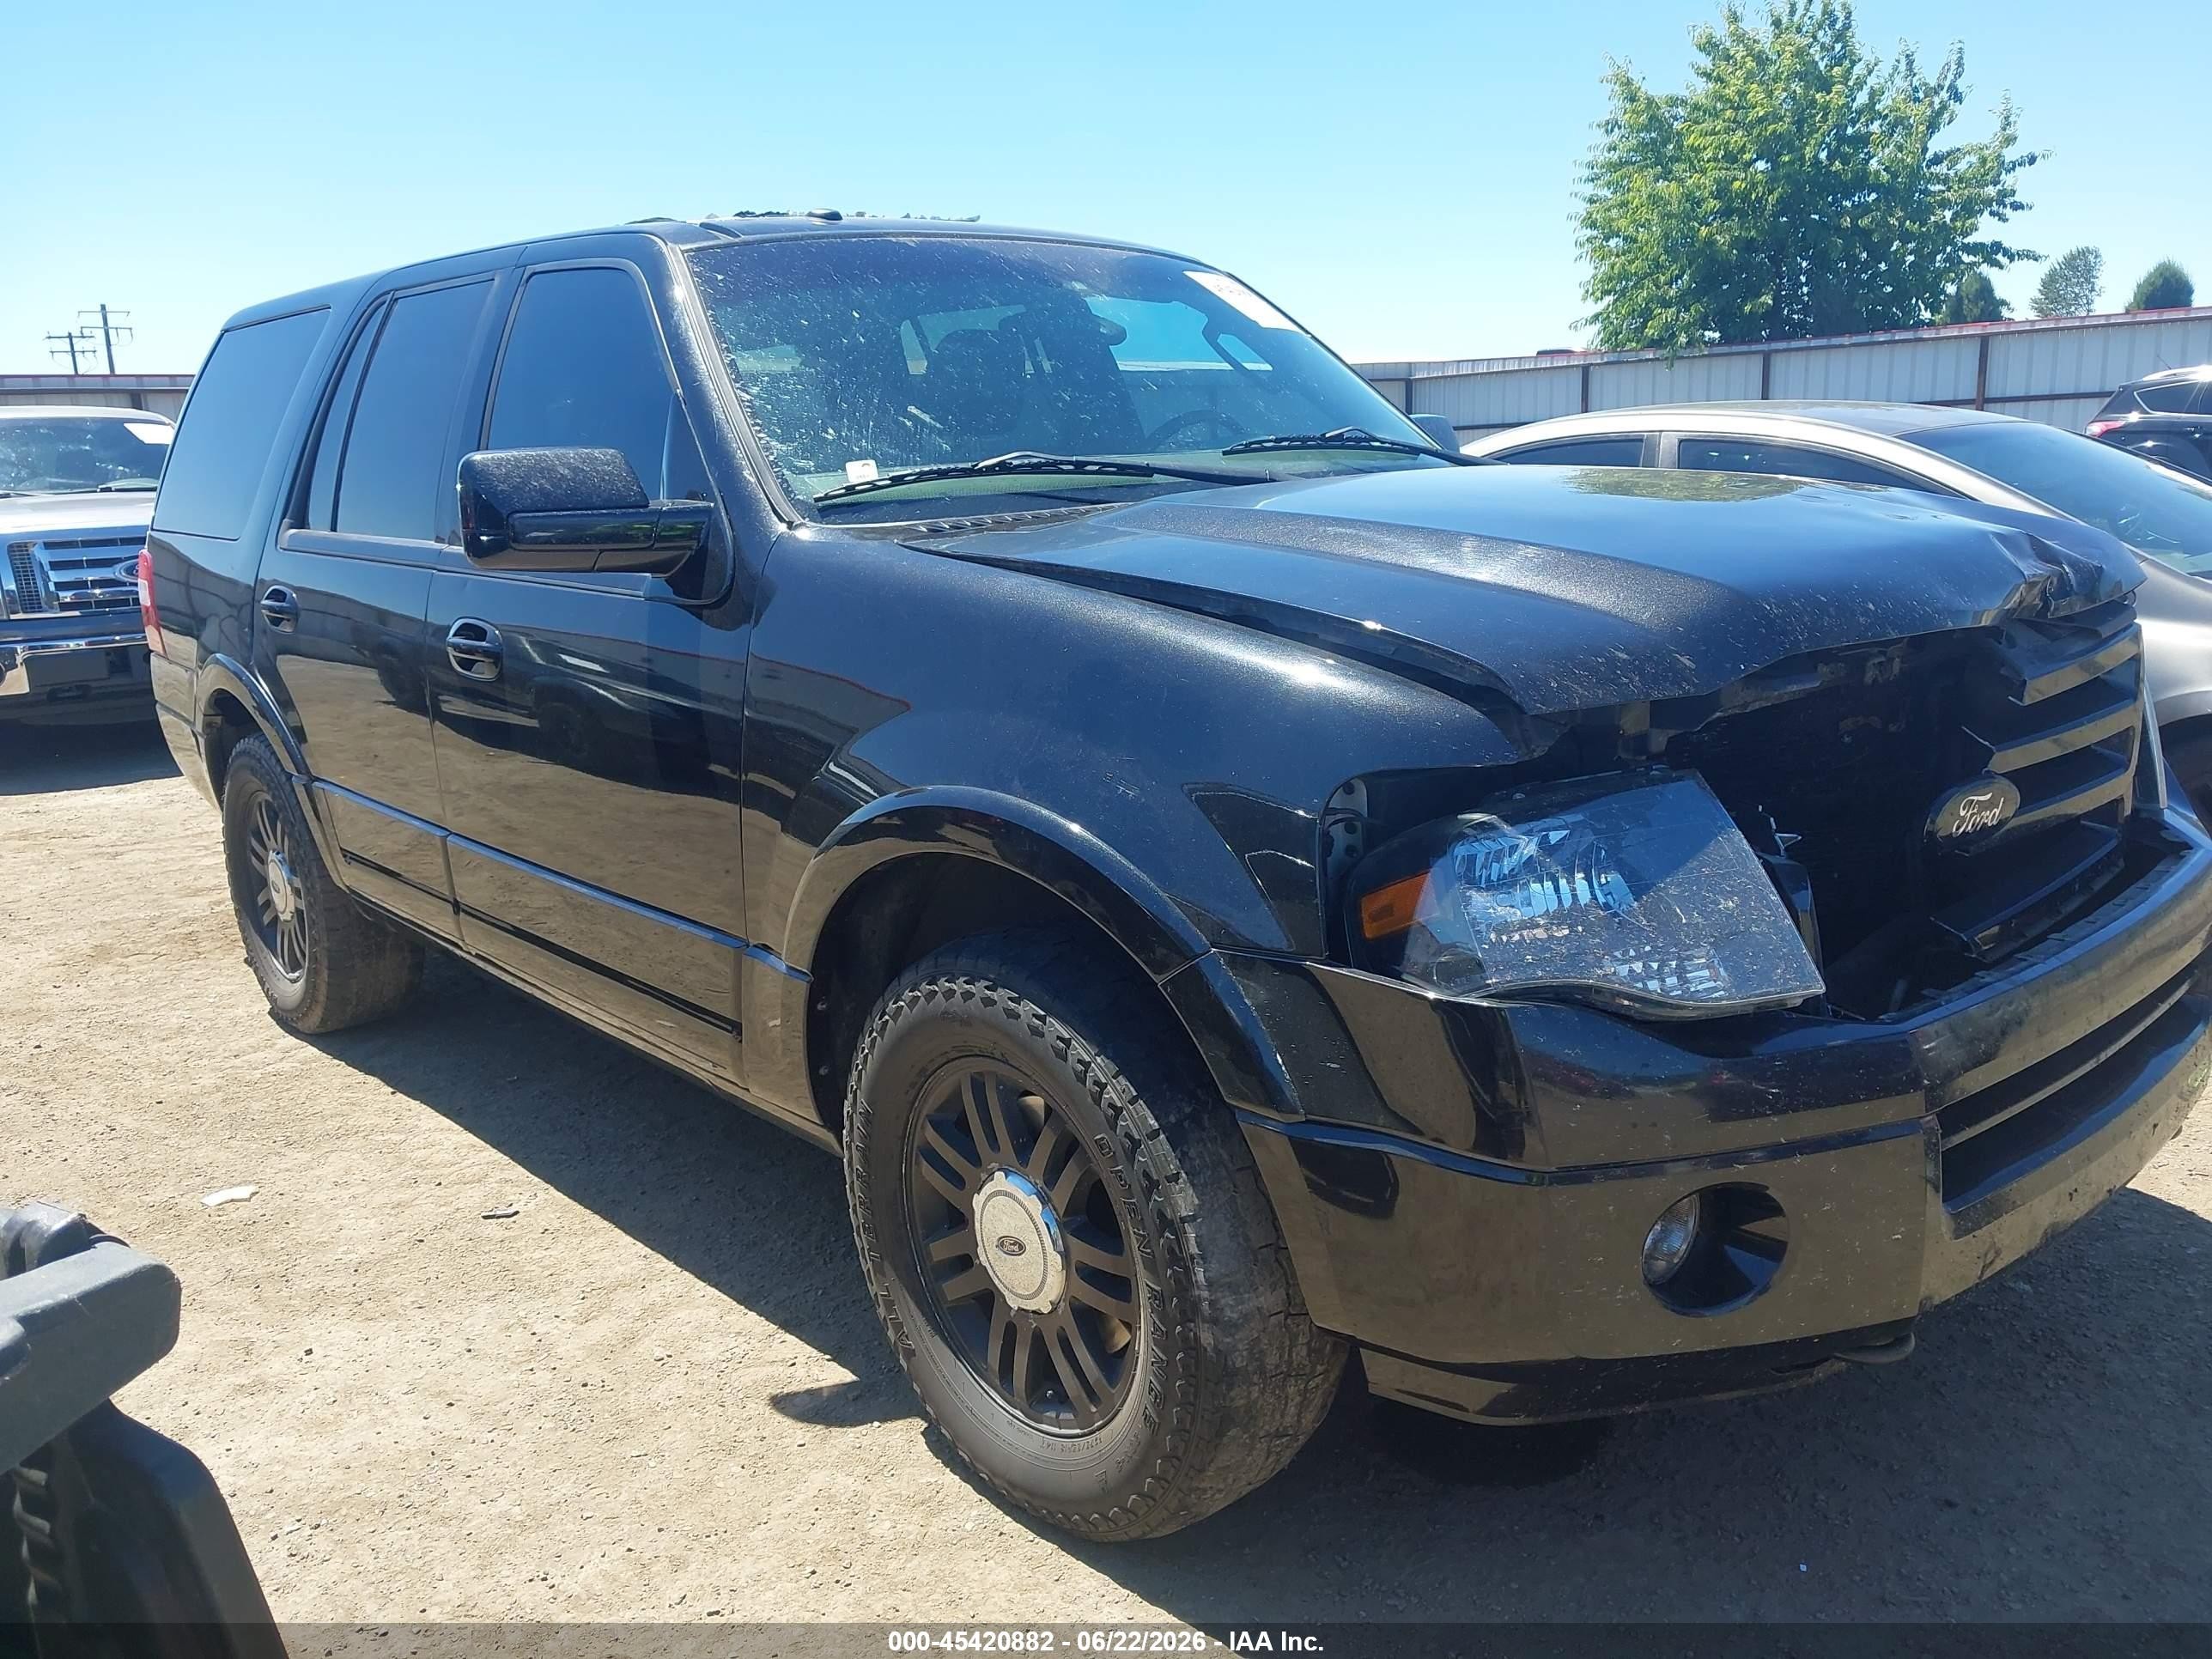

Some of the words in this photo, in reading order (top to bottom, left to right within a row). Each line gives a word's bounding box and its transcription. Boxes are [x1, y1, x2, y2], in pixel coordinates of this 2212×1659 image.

[1952, 792, 2004, 837] Ford
[854, 1097, 882, 1262] TERRAIN
[1002, 1239, 1019, 1253] Ford
[879, 1282, 916, 1349] ALL
[1093, 1132, 1155, 1258] OPEN
[1140, 1279, 1169, 1437] RANGE
